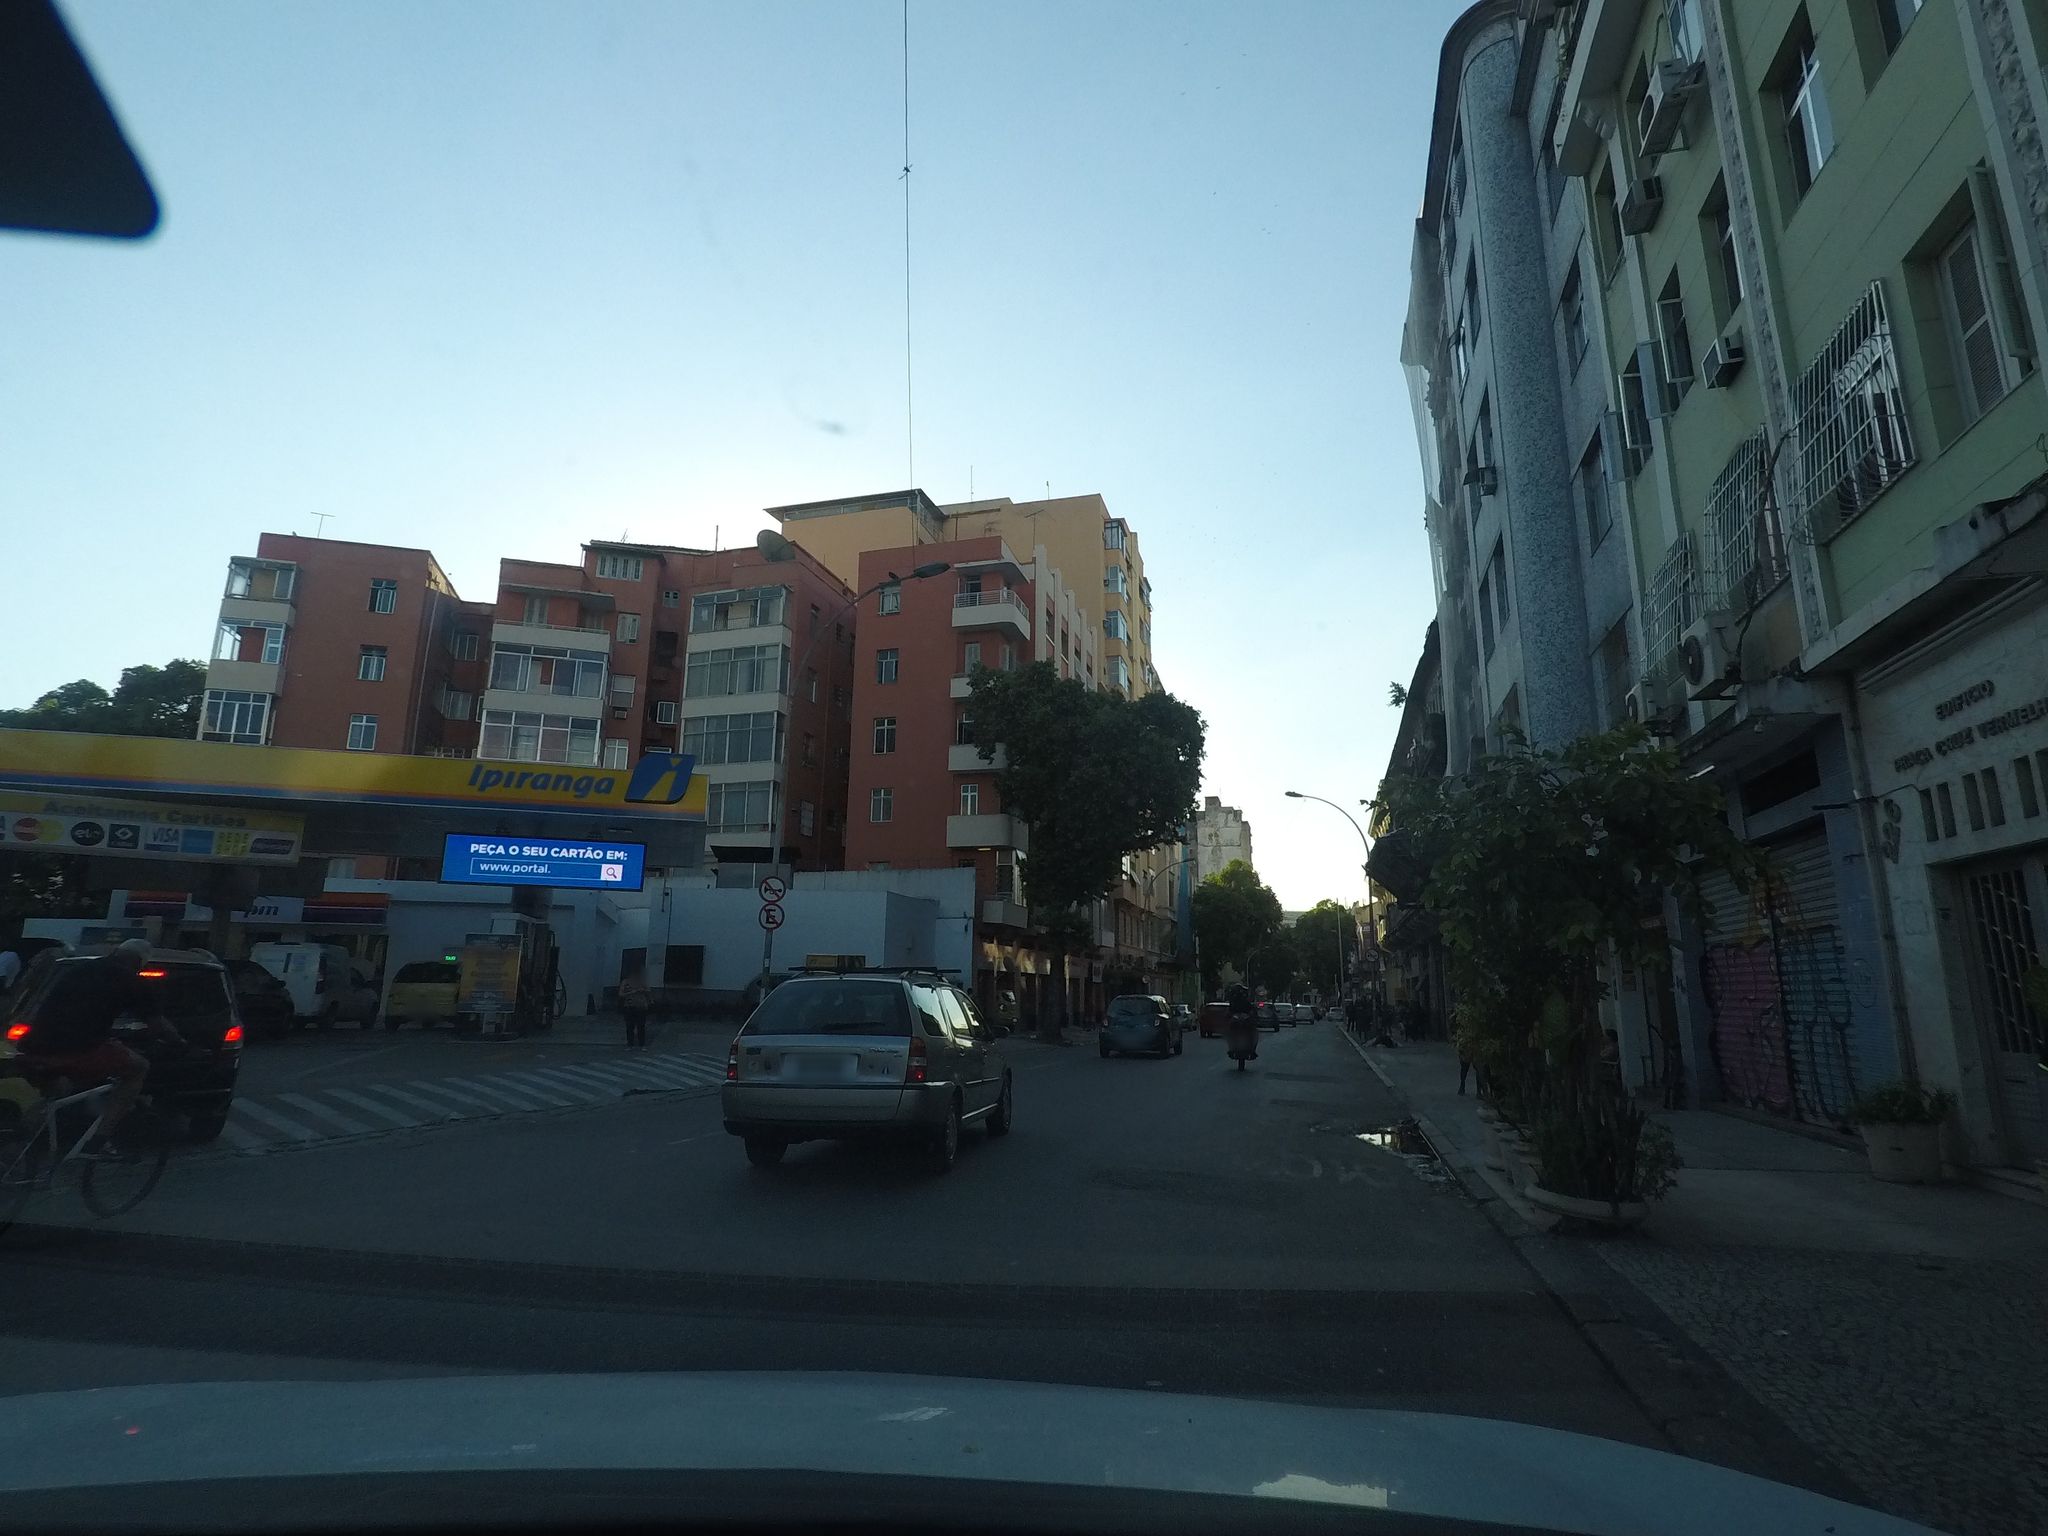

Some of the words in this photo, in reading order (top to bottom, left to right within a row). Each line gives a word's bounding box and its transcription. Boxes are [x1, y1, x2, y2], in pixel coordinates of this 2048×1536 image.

[468, 764, 615, 798] Ipiranga
[167, 809, 246, 827] Cartões
[153, 828, 180, 842] VISA
[471, 844, 506, 856] PEÇA
[509, 846, 520, 855] O
[522, 846, 548, 857] SEU
[550, 847, 603, 860] CARTÃO
[606, 850, 628, 861] EM:
[480, 862, 551, 875] www.portal.
[765, 908, 777, 924] E
